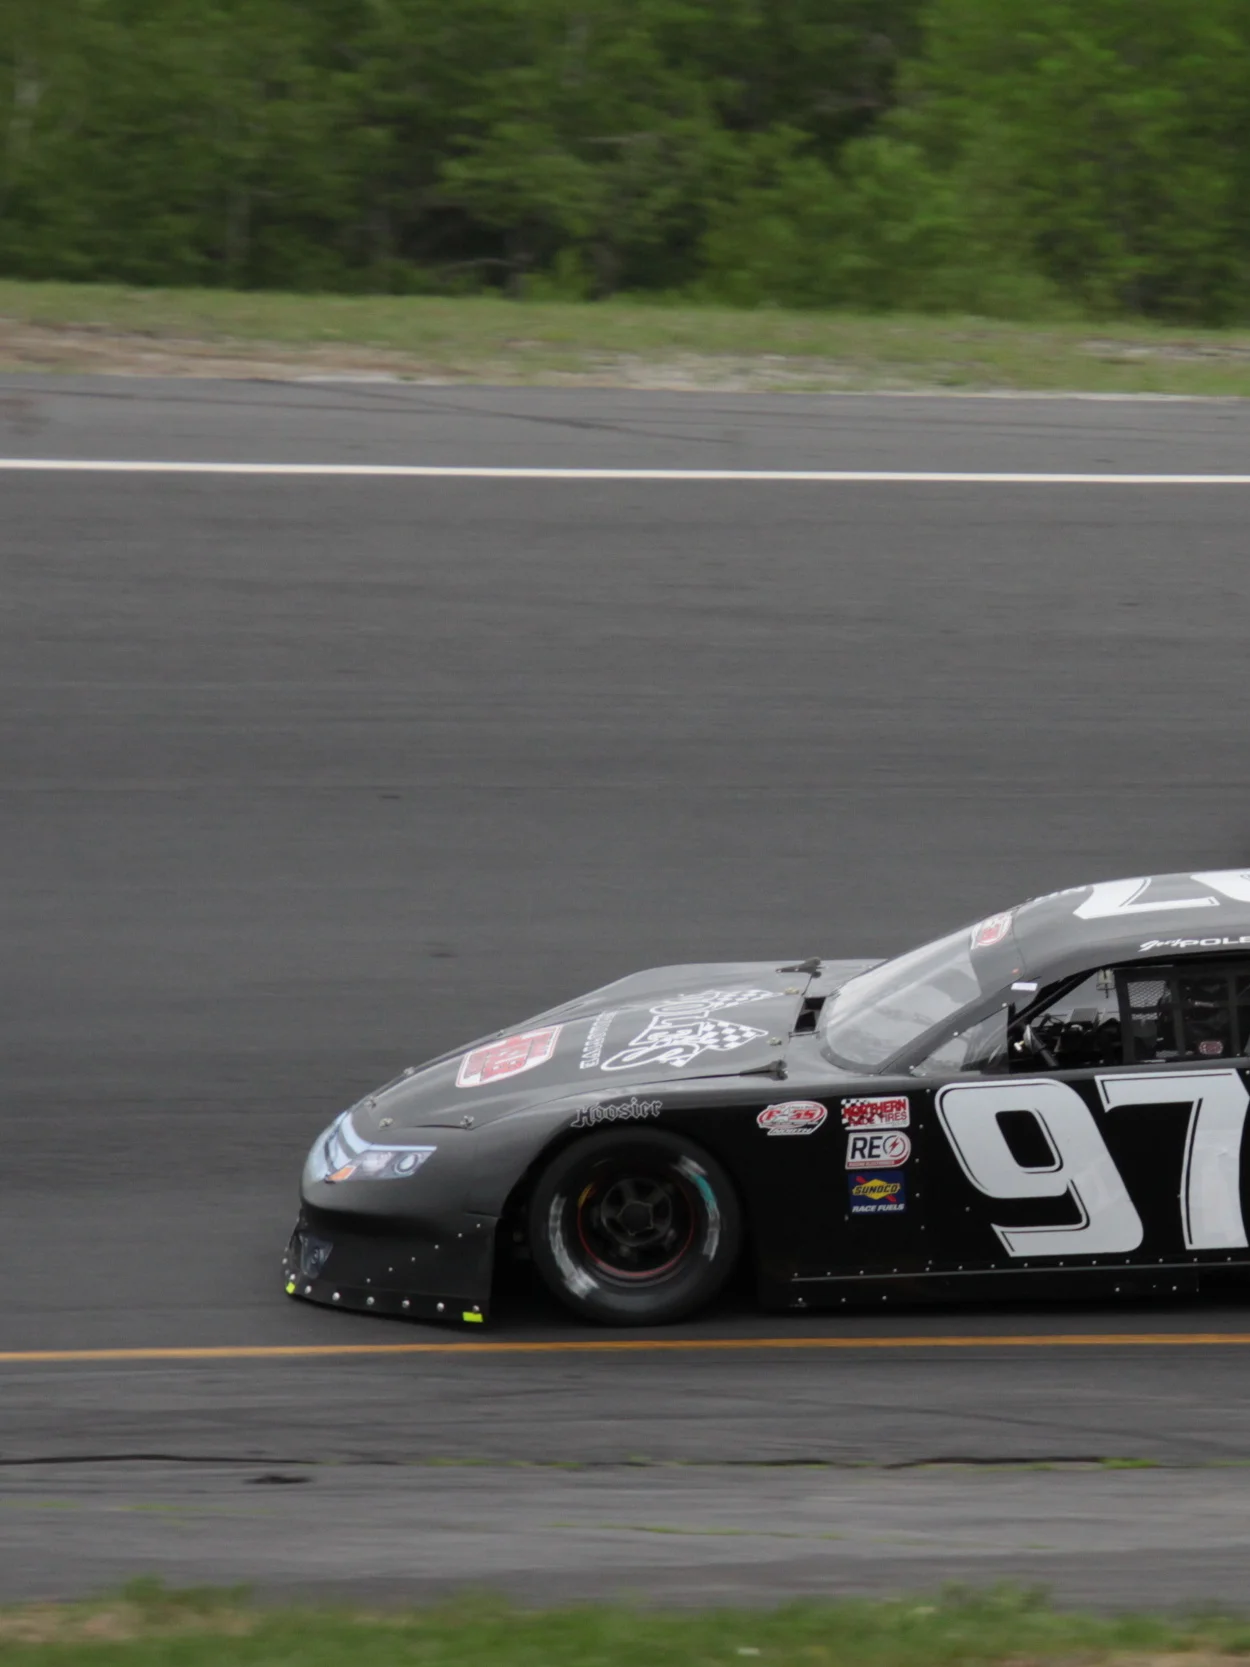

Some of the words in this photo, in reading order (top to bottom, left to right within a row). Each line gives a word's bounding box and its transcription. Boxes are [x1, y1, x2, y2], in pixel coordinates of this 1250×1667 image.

[571, 1097, 663, 1128] Hoosier
[935, 1069, 1250, 1257] 97
[855, 1184, 899, 1195] SUNOCO
